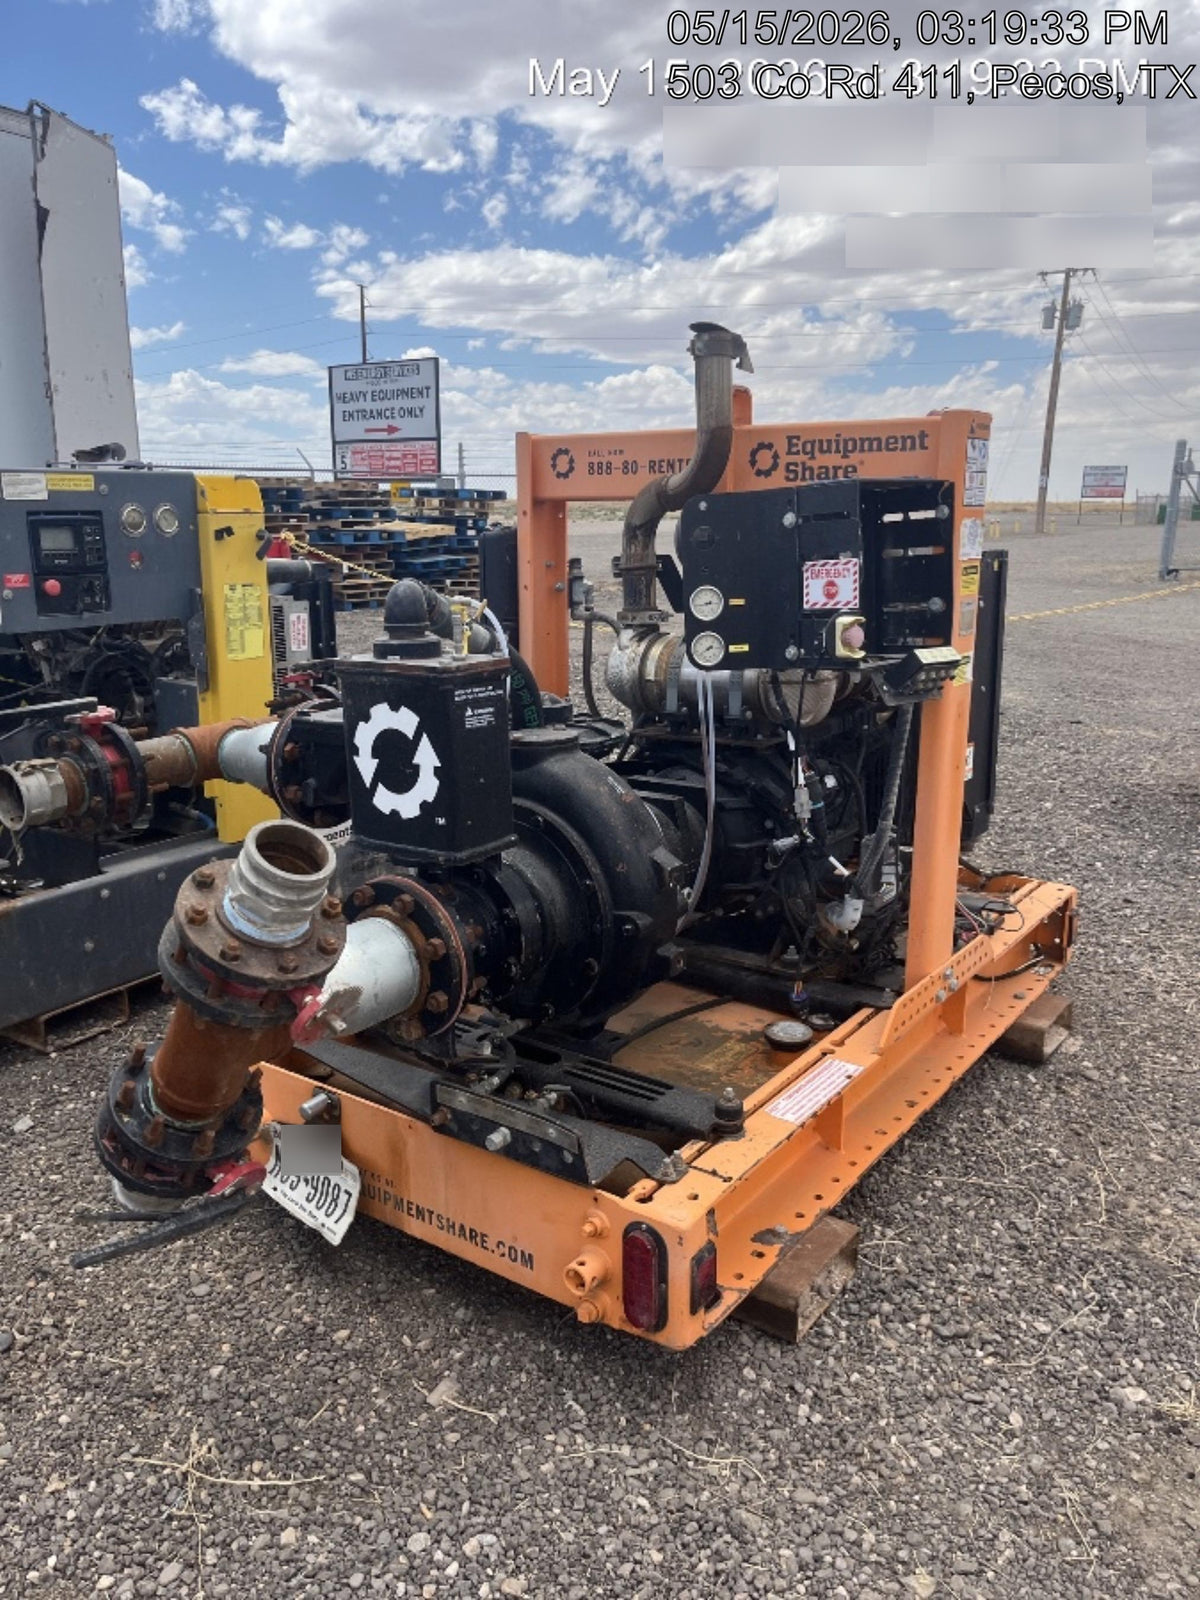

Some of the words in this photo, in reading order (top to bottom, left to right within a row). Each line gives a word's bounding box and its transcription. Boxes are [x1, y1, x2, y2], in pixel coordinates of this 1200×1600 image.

[335, 390, 368, 404] HEAVY
[371, 386, 431, 402] EQUIPMENT
[342, 407, 396, 422] ENTRANCE
[398, 405, 425, 419] ONLY
[785, 430, 929, 460] Equipment
[784, 461, 858, 482] Share
